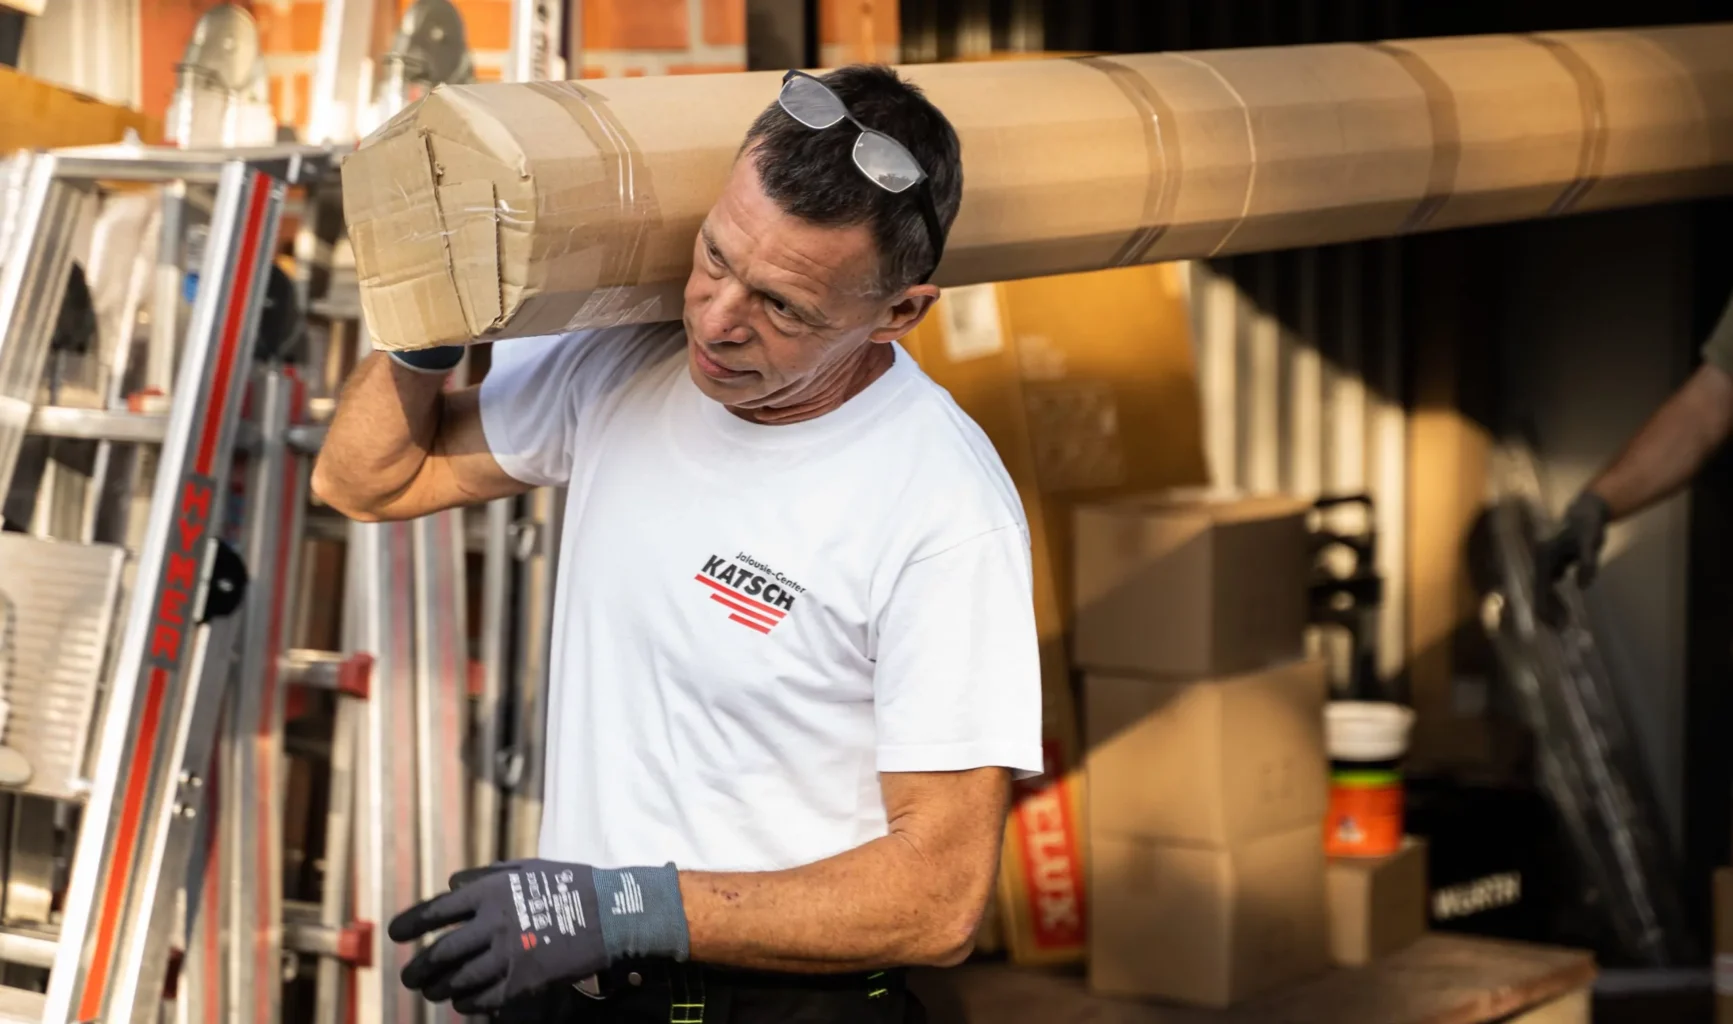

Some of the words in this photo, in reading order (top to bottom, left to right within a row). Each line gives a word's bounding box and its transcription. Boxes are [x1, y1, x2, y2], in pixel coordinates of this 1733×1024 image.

[152, 481, 213, 661] HYMER
[701, 554, 796, 611] KATSCH
[736, 551, 807, 593] Jalousie-Center
